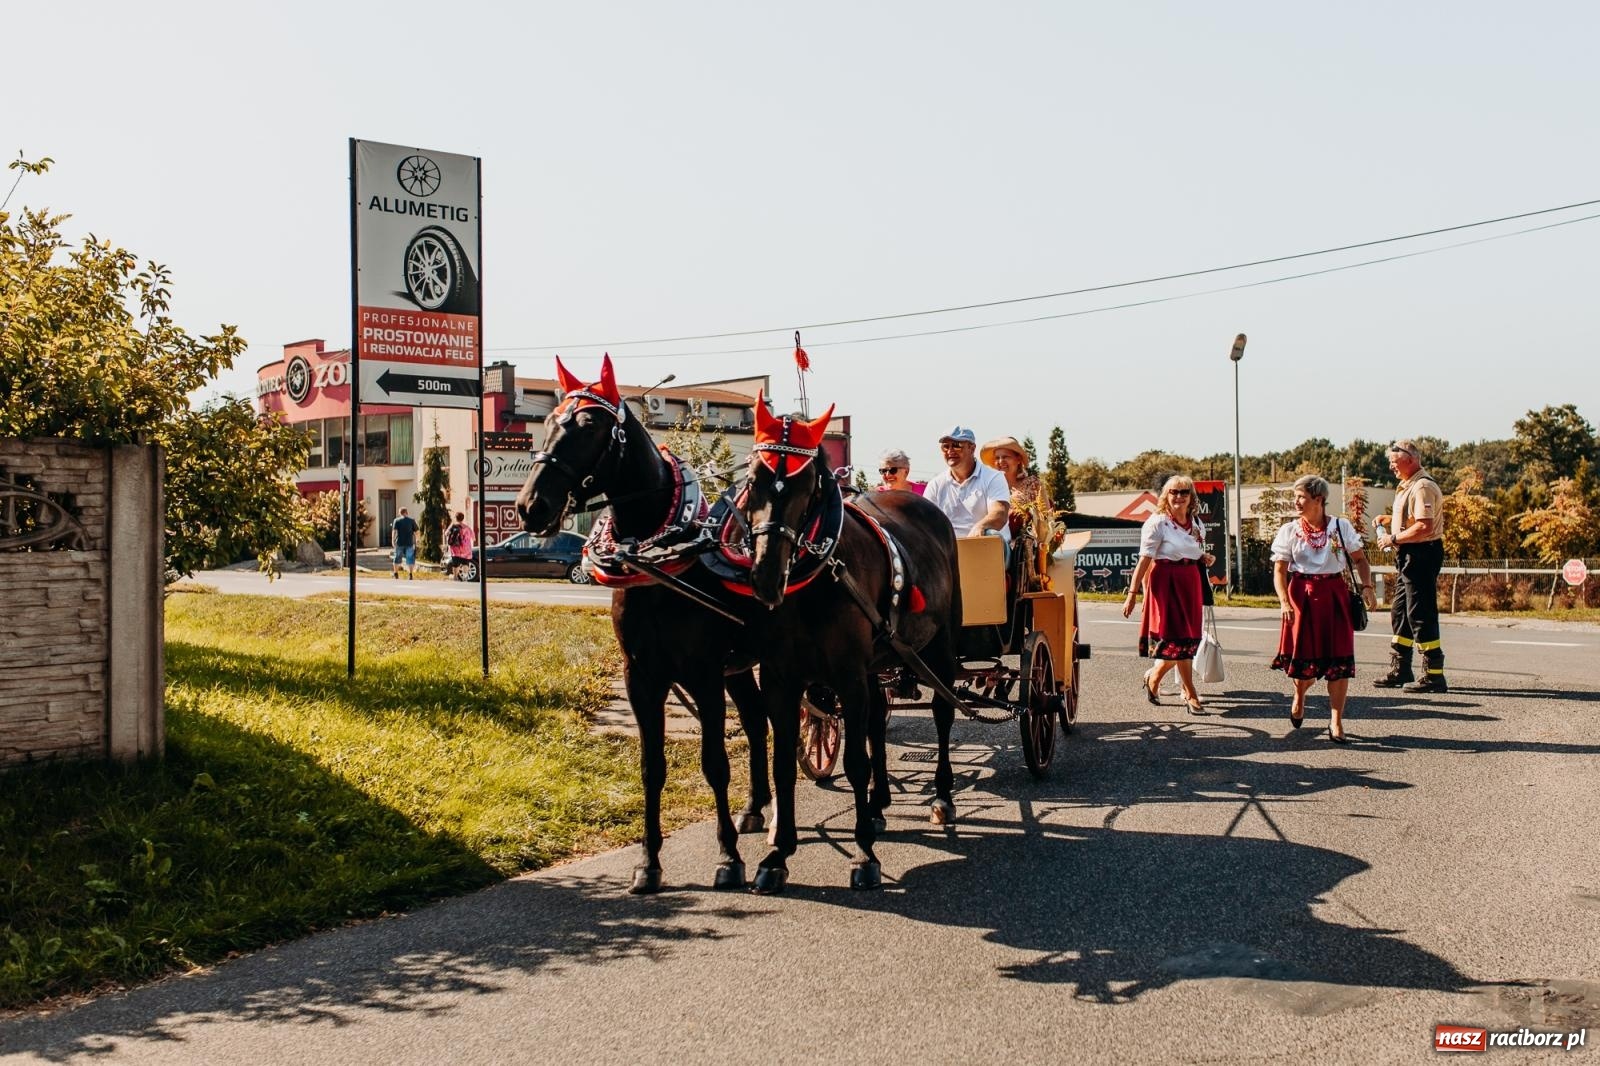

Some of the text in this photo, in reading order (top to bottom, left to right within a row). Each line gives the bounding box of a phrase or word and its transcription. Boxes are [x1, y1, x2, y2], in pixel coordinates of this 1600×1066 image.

[368, 195, 469, 223] ALUMETIG
[363, 312, 474, 331] PROFESJONALNE
[363, 327, 474, 348] PROSTOWANIE
[363, 343, 474, 360] I RENOWACJA FELG
[418, 379, 451, 392] 500m
